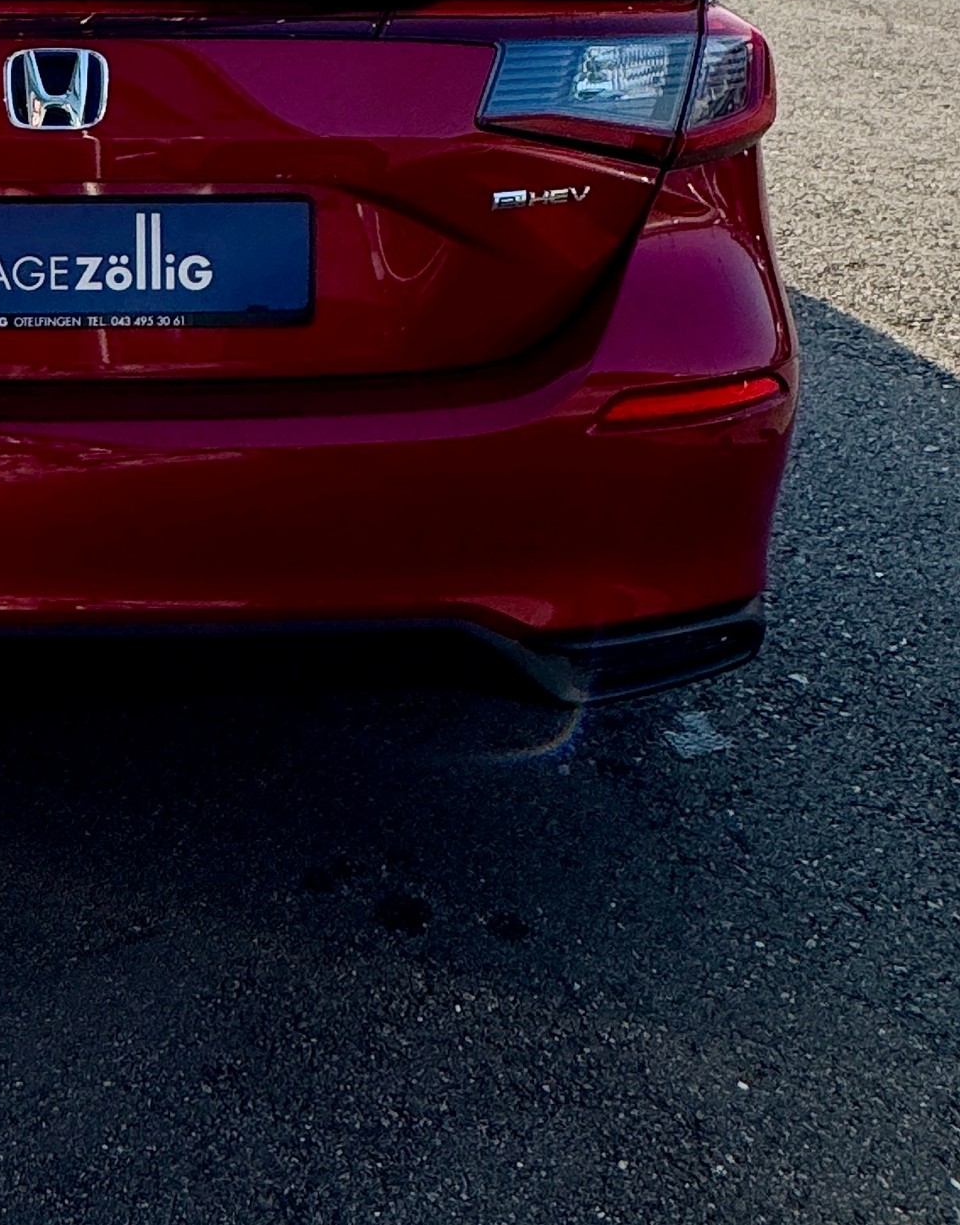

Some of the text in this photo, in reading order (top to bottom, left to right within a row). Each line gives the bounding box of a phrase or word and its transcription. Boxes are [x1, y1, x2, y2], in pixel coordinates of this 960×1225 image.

[13, 316, 82, 327] OTELFINGEN
[111, 316, 131, 327] 043
[134, 316, 154, 327] 495
[157, 315, 171, 326] 30
[173, 315, 185, 326] 61
